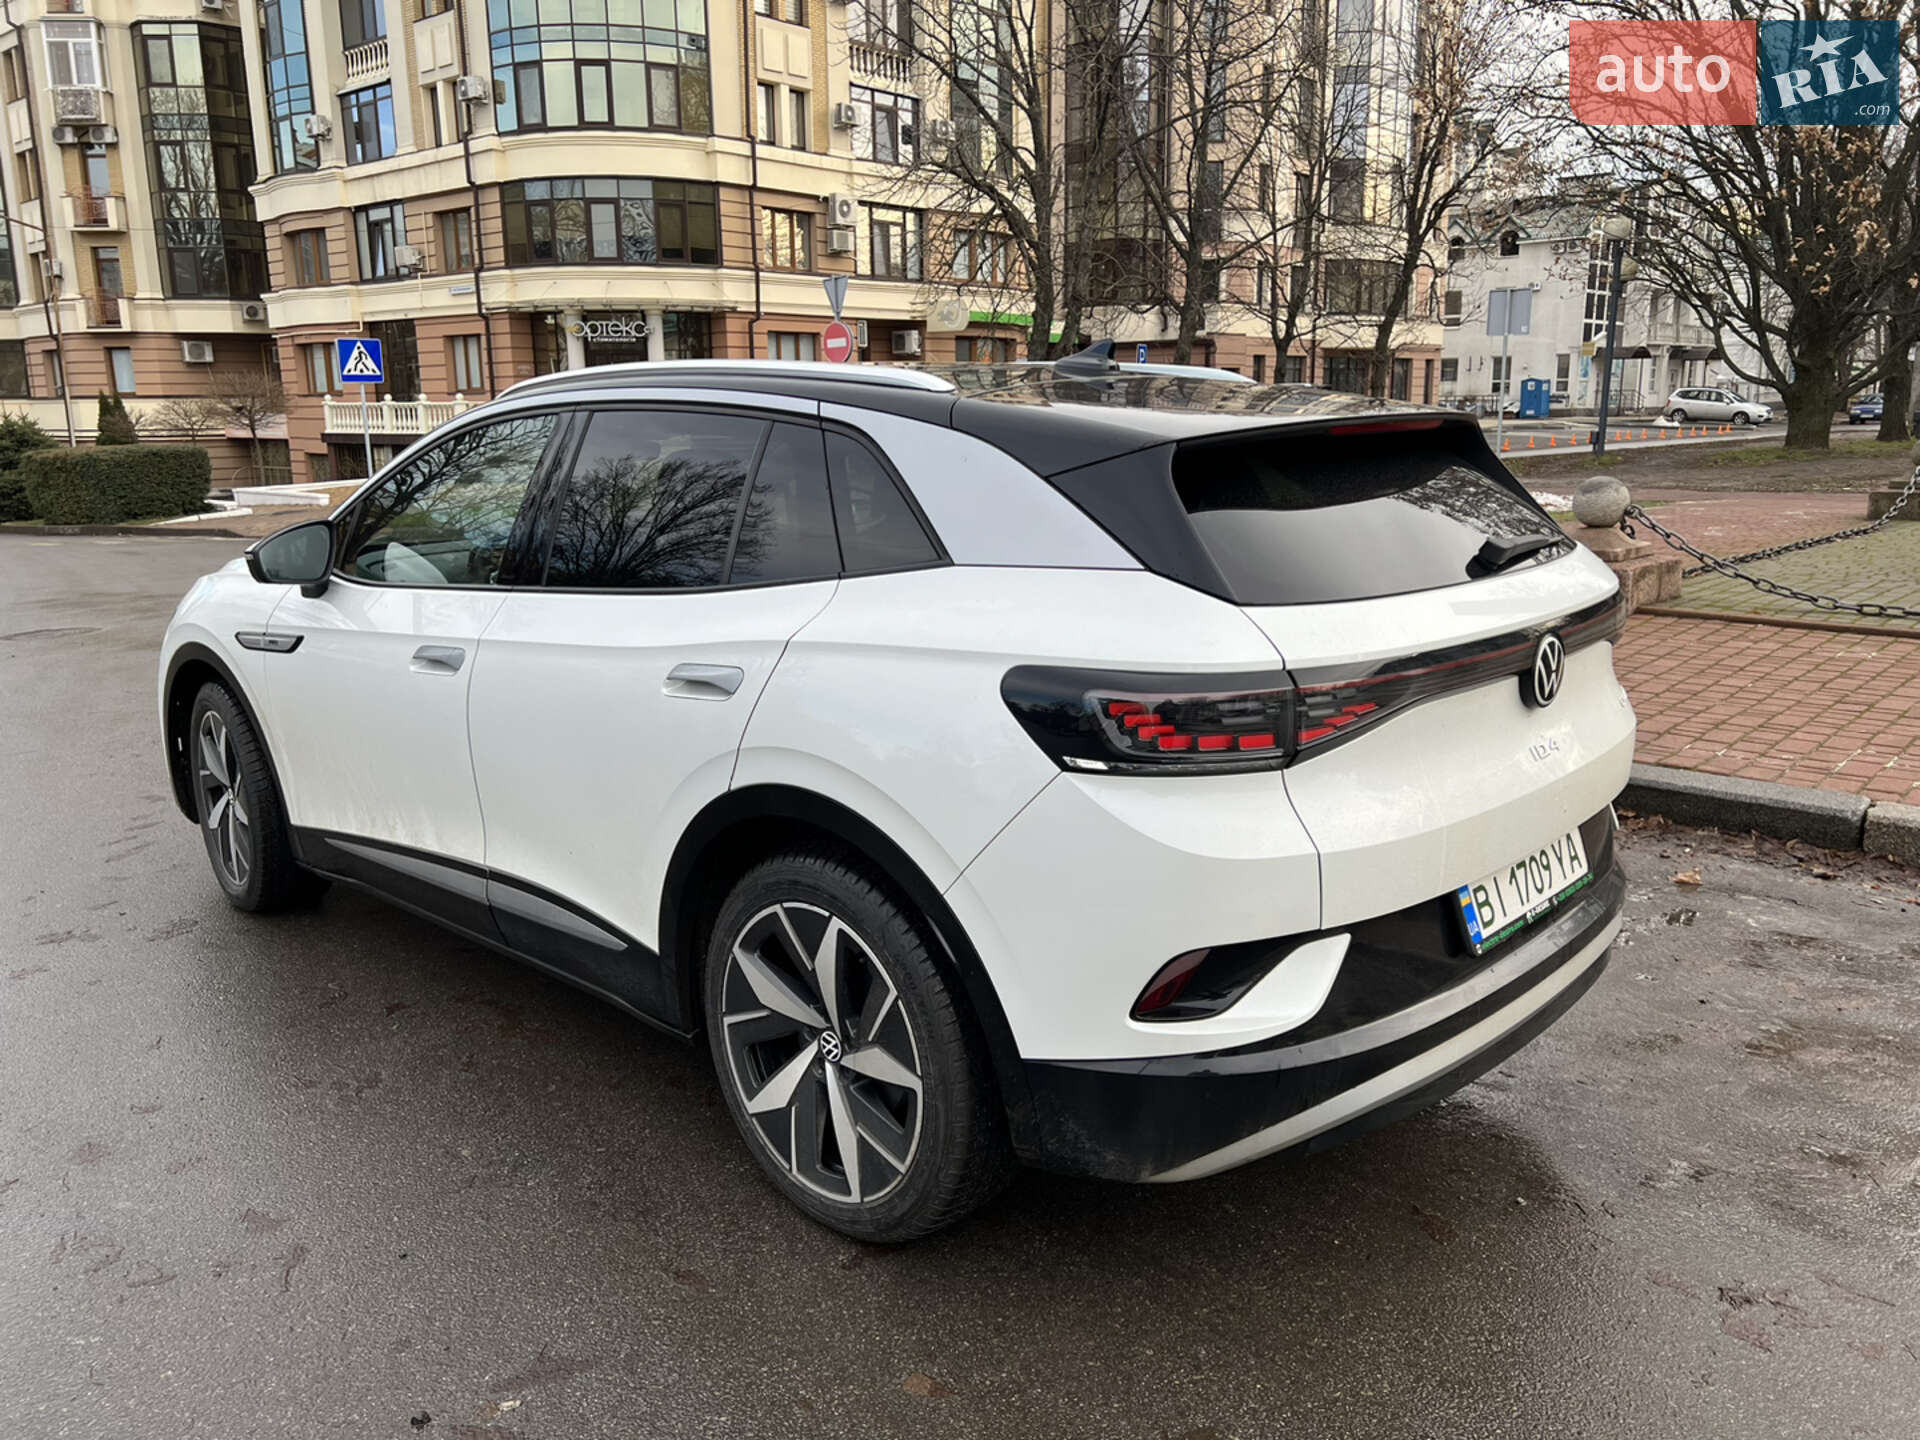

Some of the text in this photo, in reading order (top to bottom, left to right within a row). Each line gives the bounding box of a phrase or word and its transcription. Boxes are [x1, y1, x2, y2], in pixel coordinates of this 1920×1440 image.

[1472, 876, 1507, 930] BI
[1509, 849, 1553, 907] 1709
[1551, 833, 1583, 880] YA
